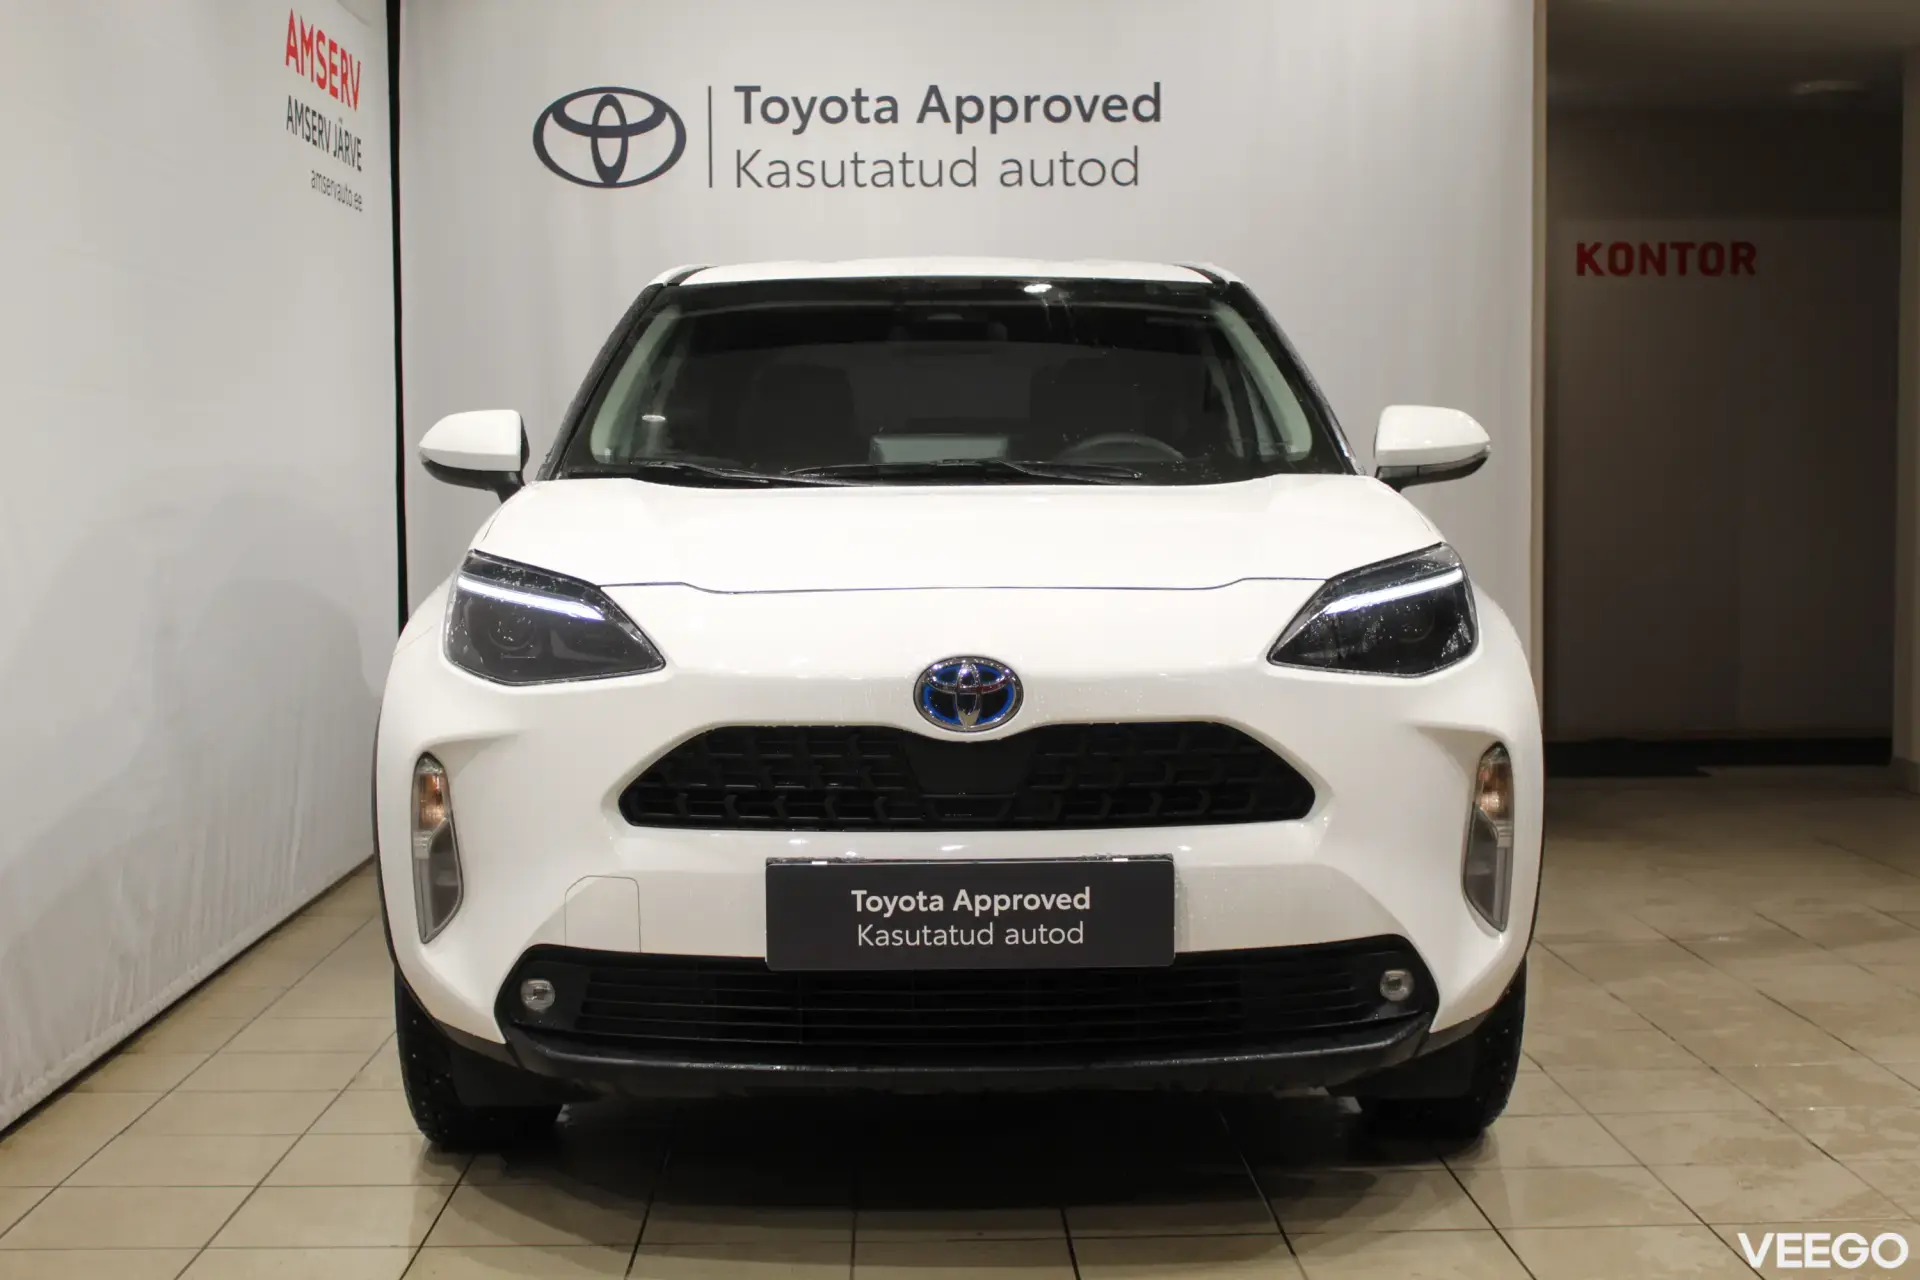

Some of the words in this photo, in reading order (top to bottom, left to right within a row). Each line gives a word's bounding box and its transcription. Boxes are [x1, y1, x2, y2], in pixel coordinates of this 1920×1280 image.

[285, 7, 361, 112] AMSERV
[733, 84, 899, 135] Toyota
[916, 82, 1162, 134] Approved
[286, 95, 332, 154] AMSERV
[333, 117, 362, 172] JÄRVE
[735, 146, 977, 188] Kasutatud
[999, 145, 1139, 187] autod
[310, 168, 363, 213] amservauto.ee
[1575, 241, 1757, 276] KONTOR
[851, 889, 944, 918] Toyota
[952, 886, 1091, 917] Approved
[857, 922, 994, 947] Kasutatud
[1004, 921, 1084, 945] autod
